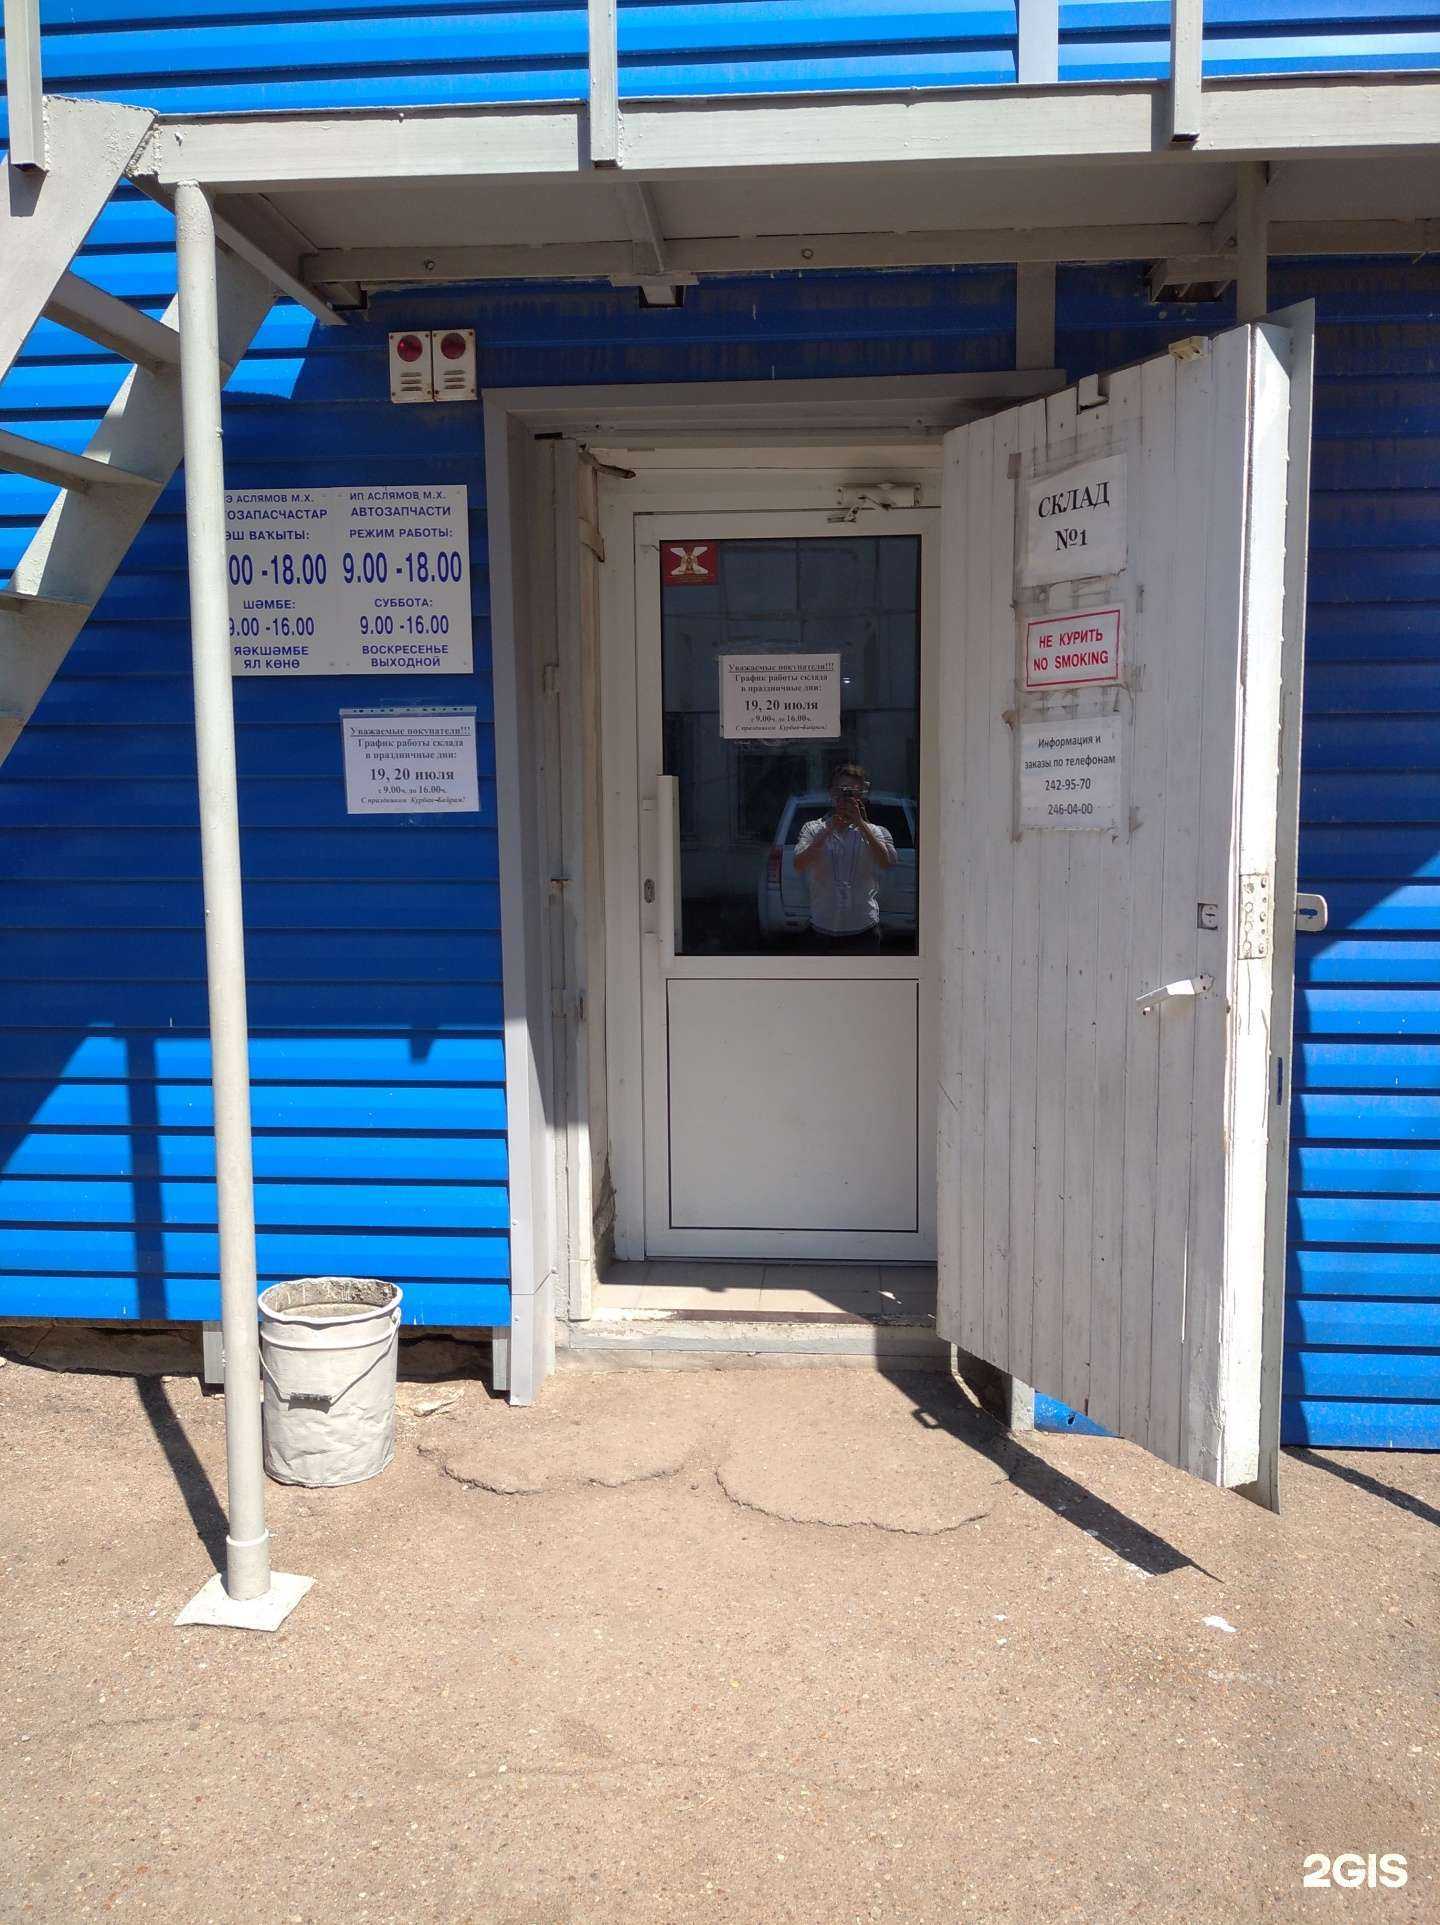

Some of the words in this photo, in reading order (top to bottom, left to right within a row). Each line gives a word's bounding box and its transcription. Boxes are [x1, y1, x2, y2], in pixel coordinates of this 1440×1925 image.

[236, 494, 288, 503] АСЛЯМОВ
[350, 492, 364, 501] ИП
[367, 491, 420, 501] АСЛЯМОВ
[1038, 480, 1110, 518] СКЛАД
[227, 509, 328, 520] ОЗАПАСЧАСТАР
[351, 506, 451, 517] АВТОЗАПЧАСТИ
[349, 529, 395, 538] РЕЖИМ
[399, 528, 453, 538] РАБОТЫ:
[229, 554, 253, 586] 00
[342, 552, 388, 584] 9.00
[374, 598, 433, 608] СУББОТА:
[360, 615, 394, 635] 9.00
[1039, 635, 1053, 649] НЕ
[1059, 628, 1104, 647] КУРИТЬ
[362, 645, 449, 655] ВОСКРЕСЕНЬЕ
[244, 659, 261, 669] ЯЛ
[371, 656, 441, 669] ВЫХОДНОЙ
[1033, 657, 1049, 672] NO
[1054, 650, 1109, 670] SMOKING
[766, 699, 780, 711] 20
[784, 701, 819, 711] июля
[1038, 736, 1093, 750] Информация
[1095, 736, 1102, 744] и
[1024, 759, 1052, 769] заказы
[1053, 758, 1064, 767] по
[1066, 755, 1116, 767] телефонам
[370, 768, 390, 782] 19,
[394, 768, 410, 781] 20
[415, 771, 454, 780] июля
[1045, 778, 1091, 791] 242-95-70
